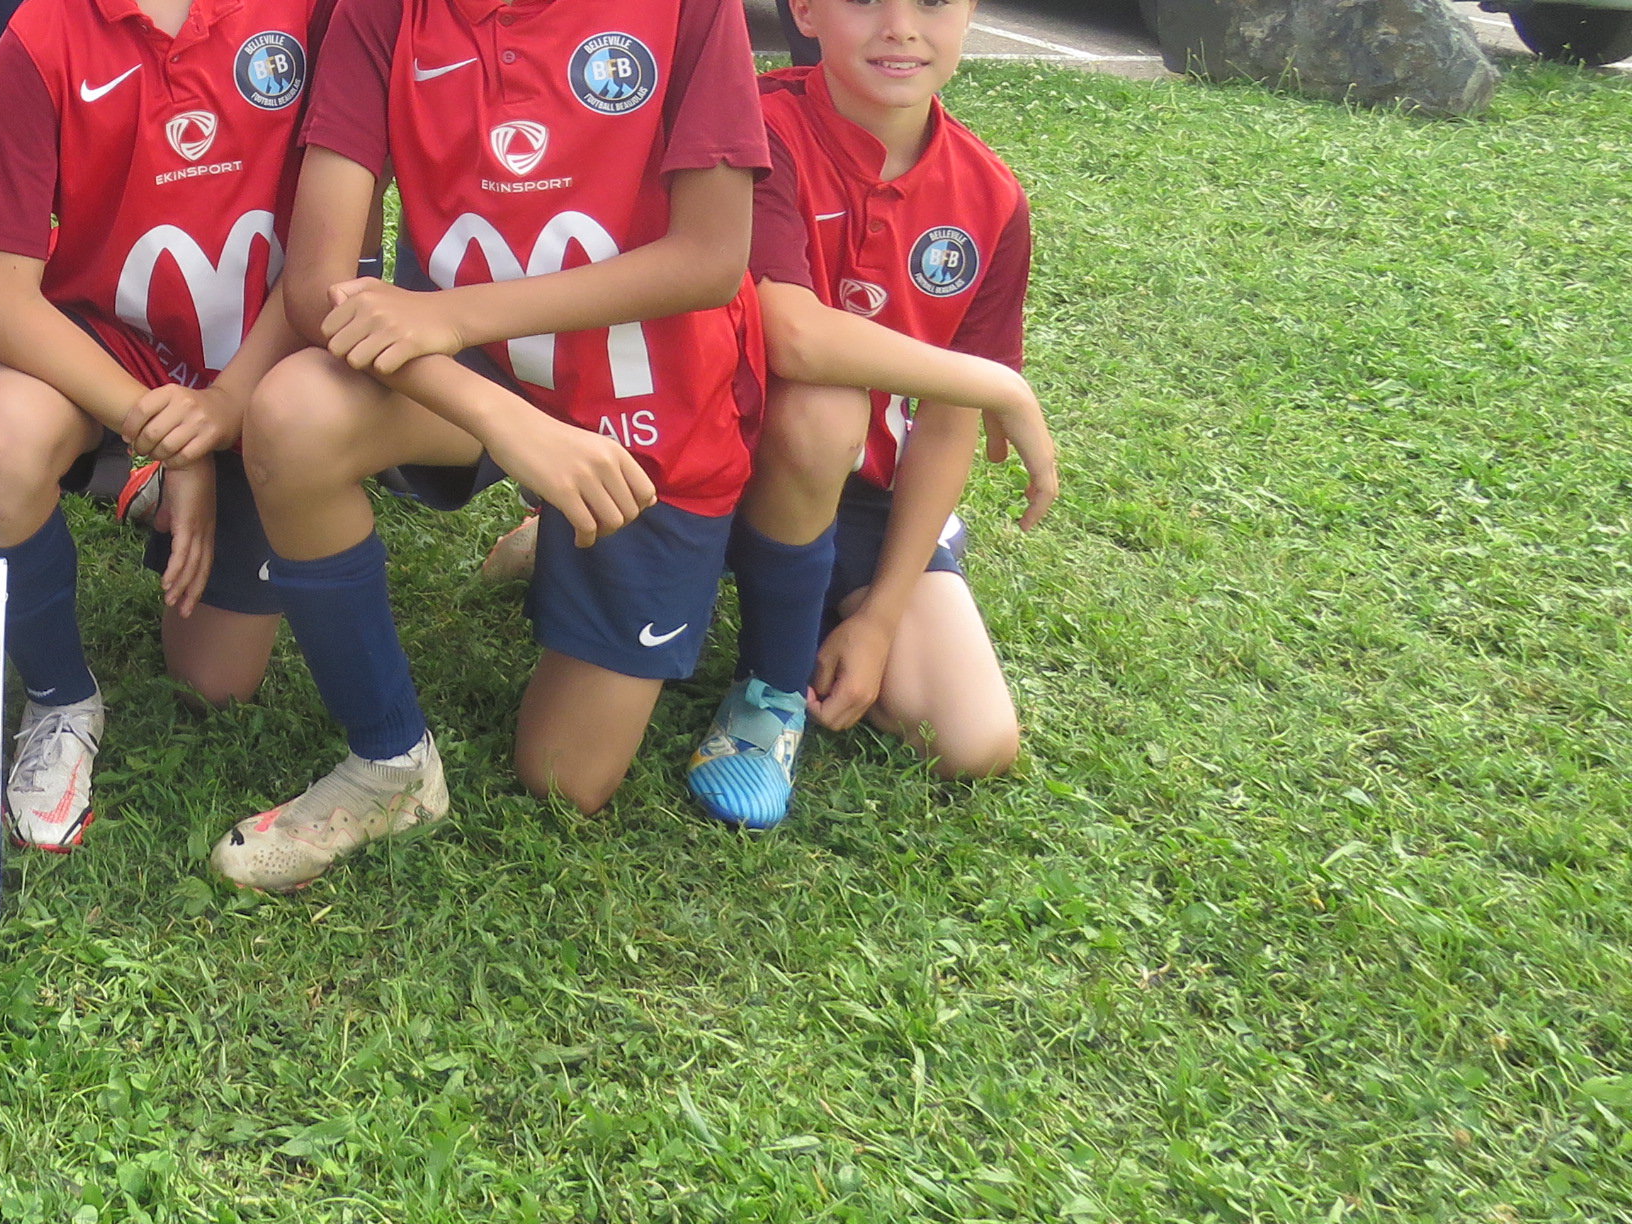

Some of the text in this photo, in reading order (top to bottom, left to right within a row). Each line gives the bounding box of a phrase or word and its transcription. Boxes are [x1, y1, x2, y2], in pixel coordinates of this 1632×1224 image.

[244, 35, 285, 55] BELLEVILLE
[583, 36, 632, 54] BELLEVILLE
[253, 54, 288, 79] BFB
[591, 57, 632, 81] BFB
[584, 93, 615, 111] FOOTBALL
[155, 160, 242, 185] EKINSPORT
[481, 177, 572, 193] EKINSPORT
[930, 248, 959, 268] BFB
